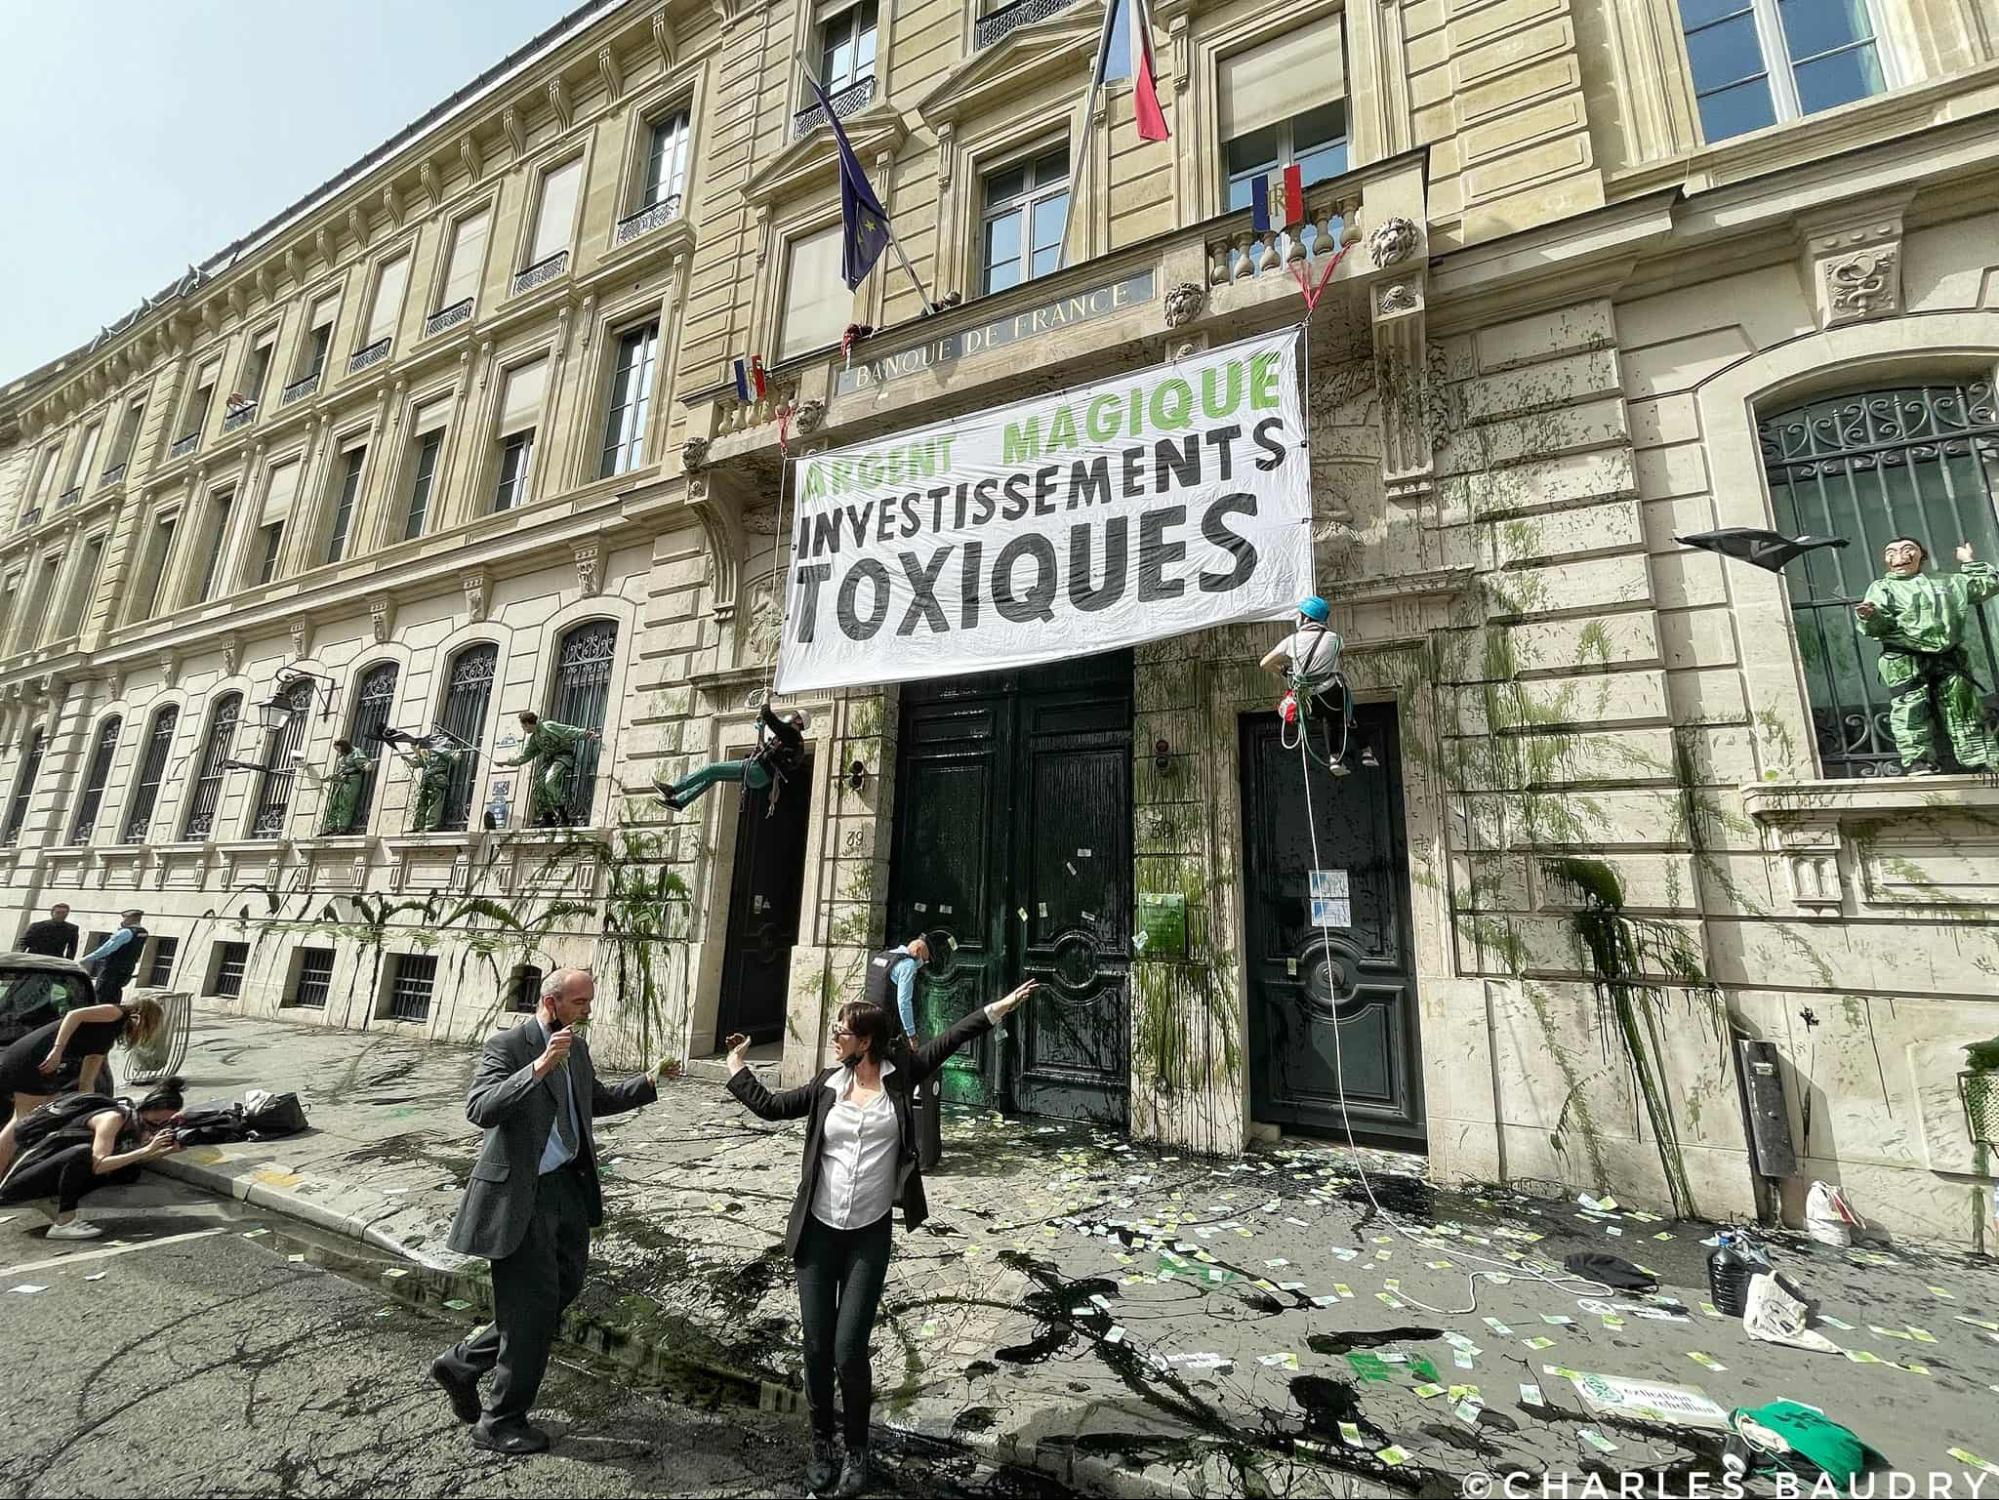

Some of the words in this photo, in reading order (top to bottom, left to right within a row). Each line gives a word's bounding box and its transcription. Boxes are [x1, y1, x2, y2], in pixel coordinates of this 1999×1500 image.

[856, 338, 953, 388] BANQUE
[966, 326, 999, 352] DE
[1014, 281, 1130, 339] FRANCE
[799, 417, 1286, 559] INVESTISSEMENTS
[800, 434, 958, 502] ARGENT
[1002, 350, 1282, 465] MAGIQUE
[796, 492, 1259, 643] TOXIQUES
[846, 830, 864, 847] 39
